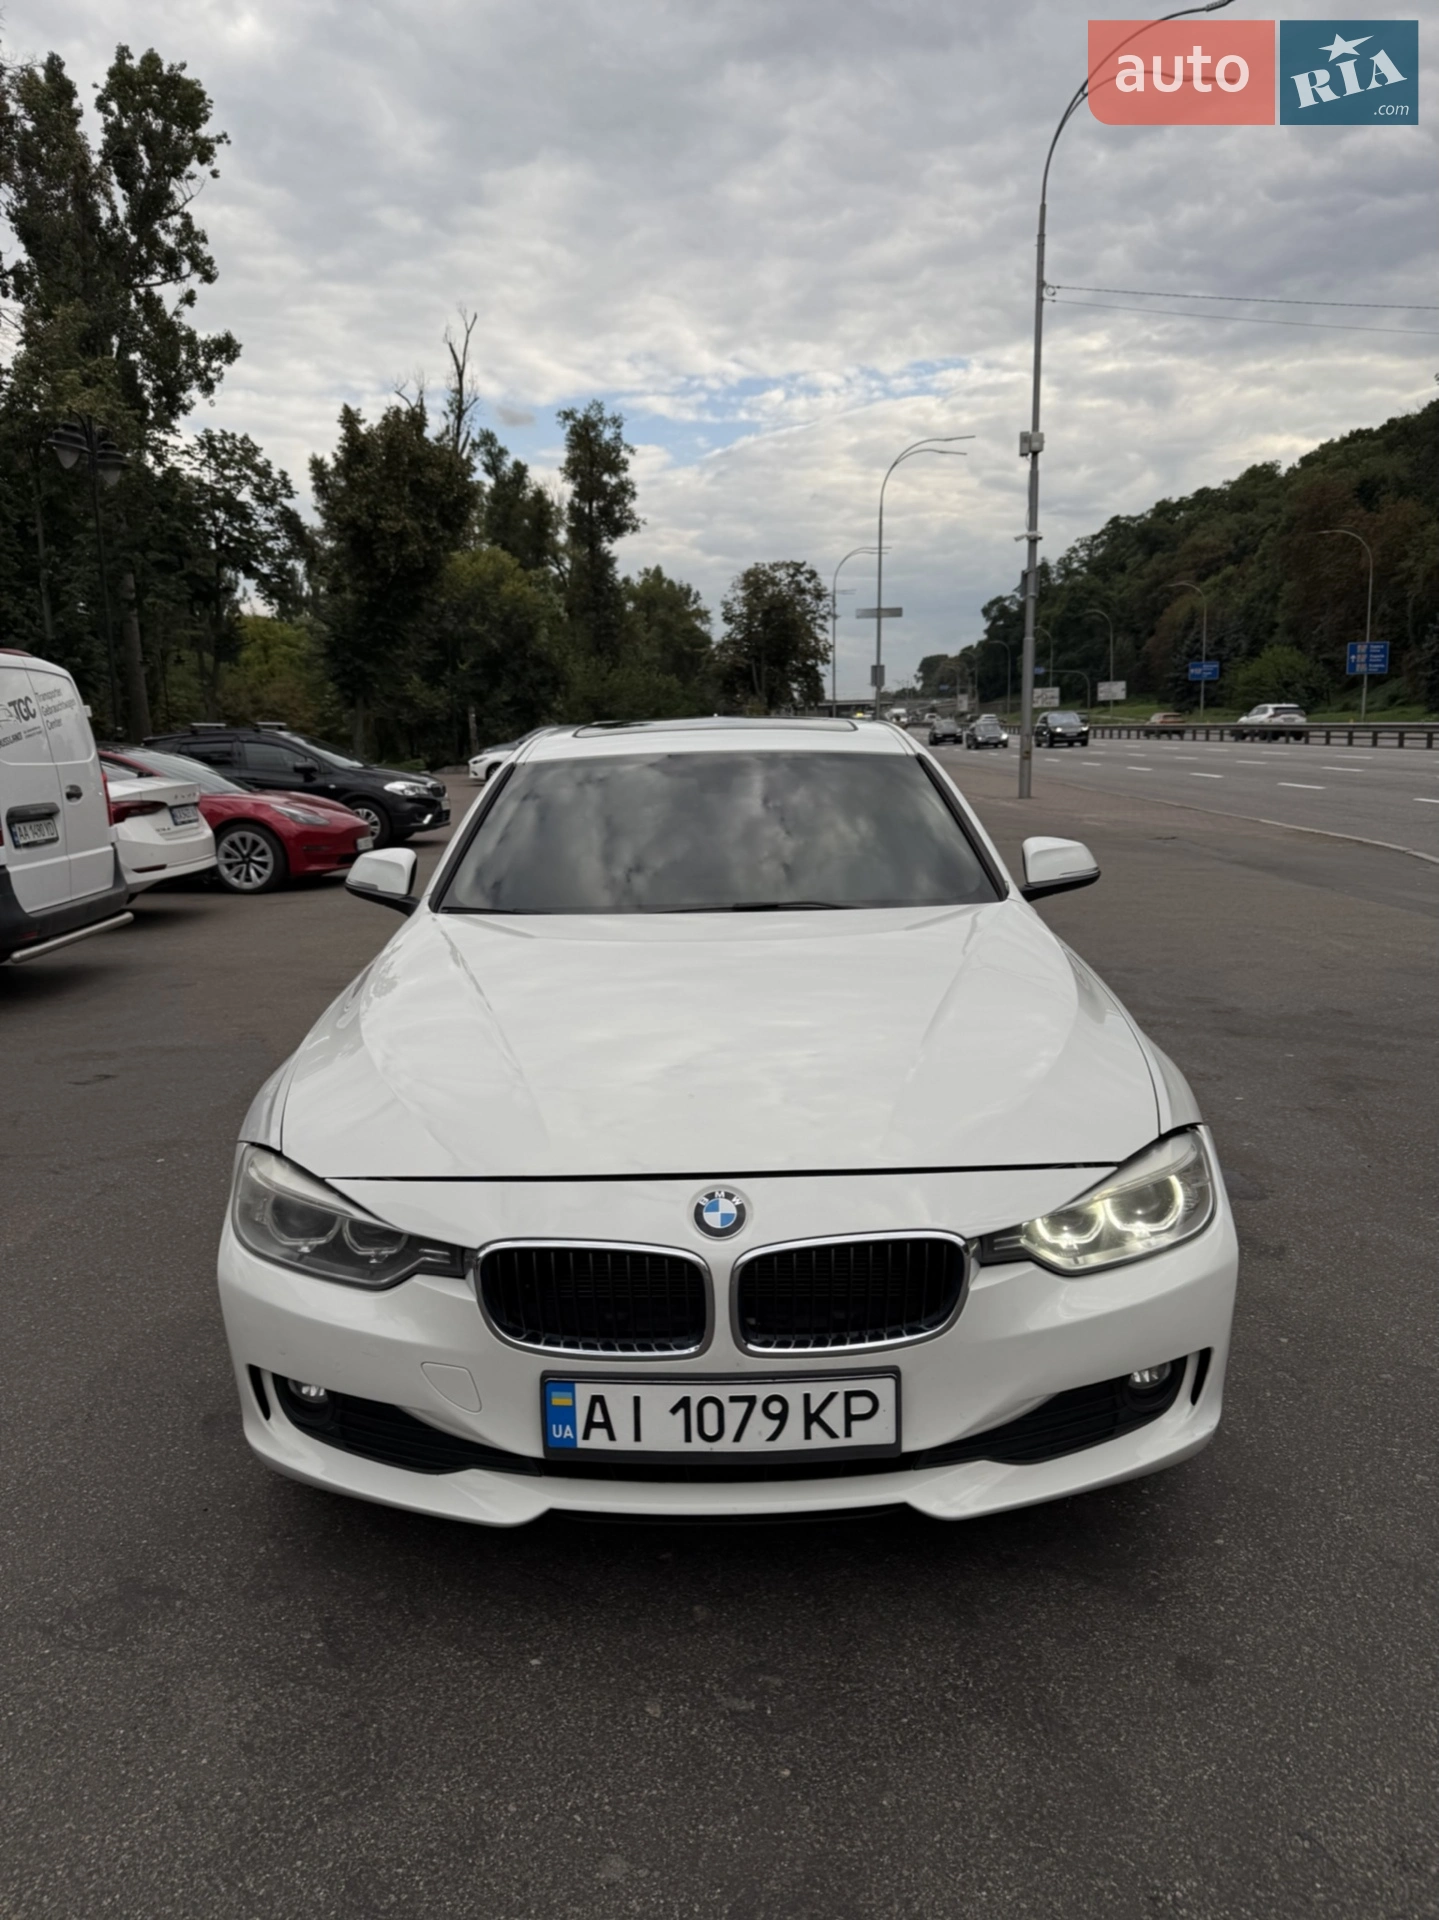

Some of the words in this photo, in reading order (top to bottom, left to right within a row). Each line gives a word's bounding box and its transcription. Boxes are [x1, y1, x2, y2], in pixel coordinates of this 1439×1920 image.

[7, 696, 36, 723] TGC
[698, 1190, 743, 1206] BMW
[582, 1395, 641, 1442] AI
[669, 1394, 789, 1443] 1079
[803, 1389, 880, 1440] KP
[552, 1424, 574, 1439] UA
